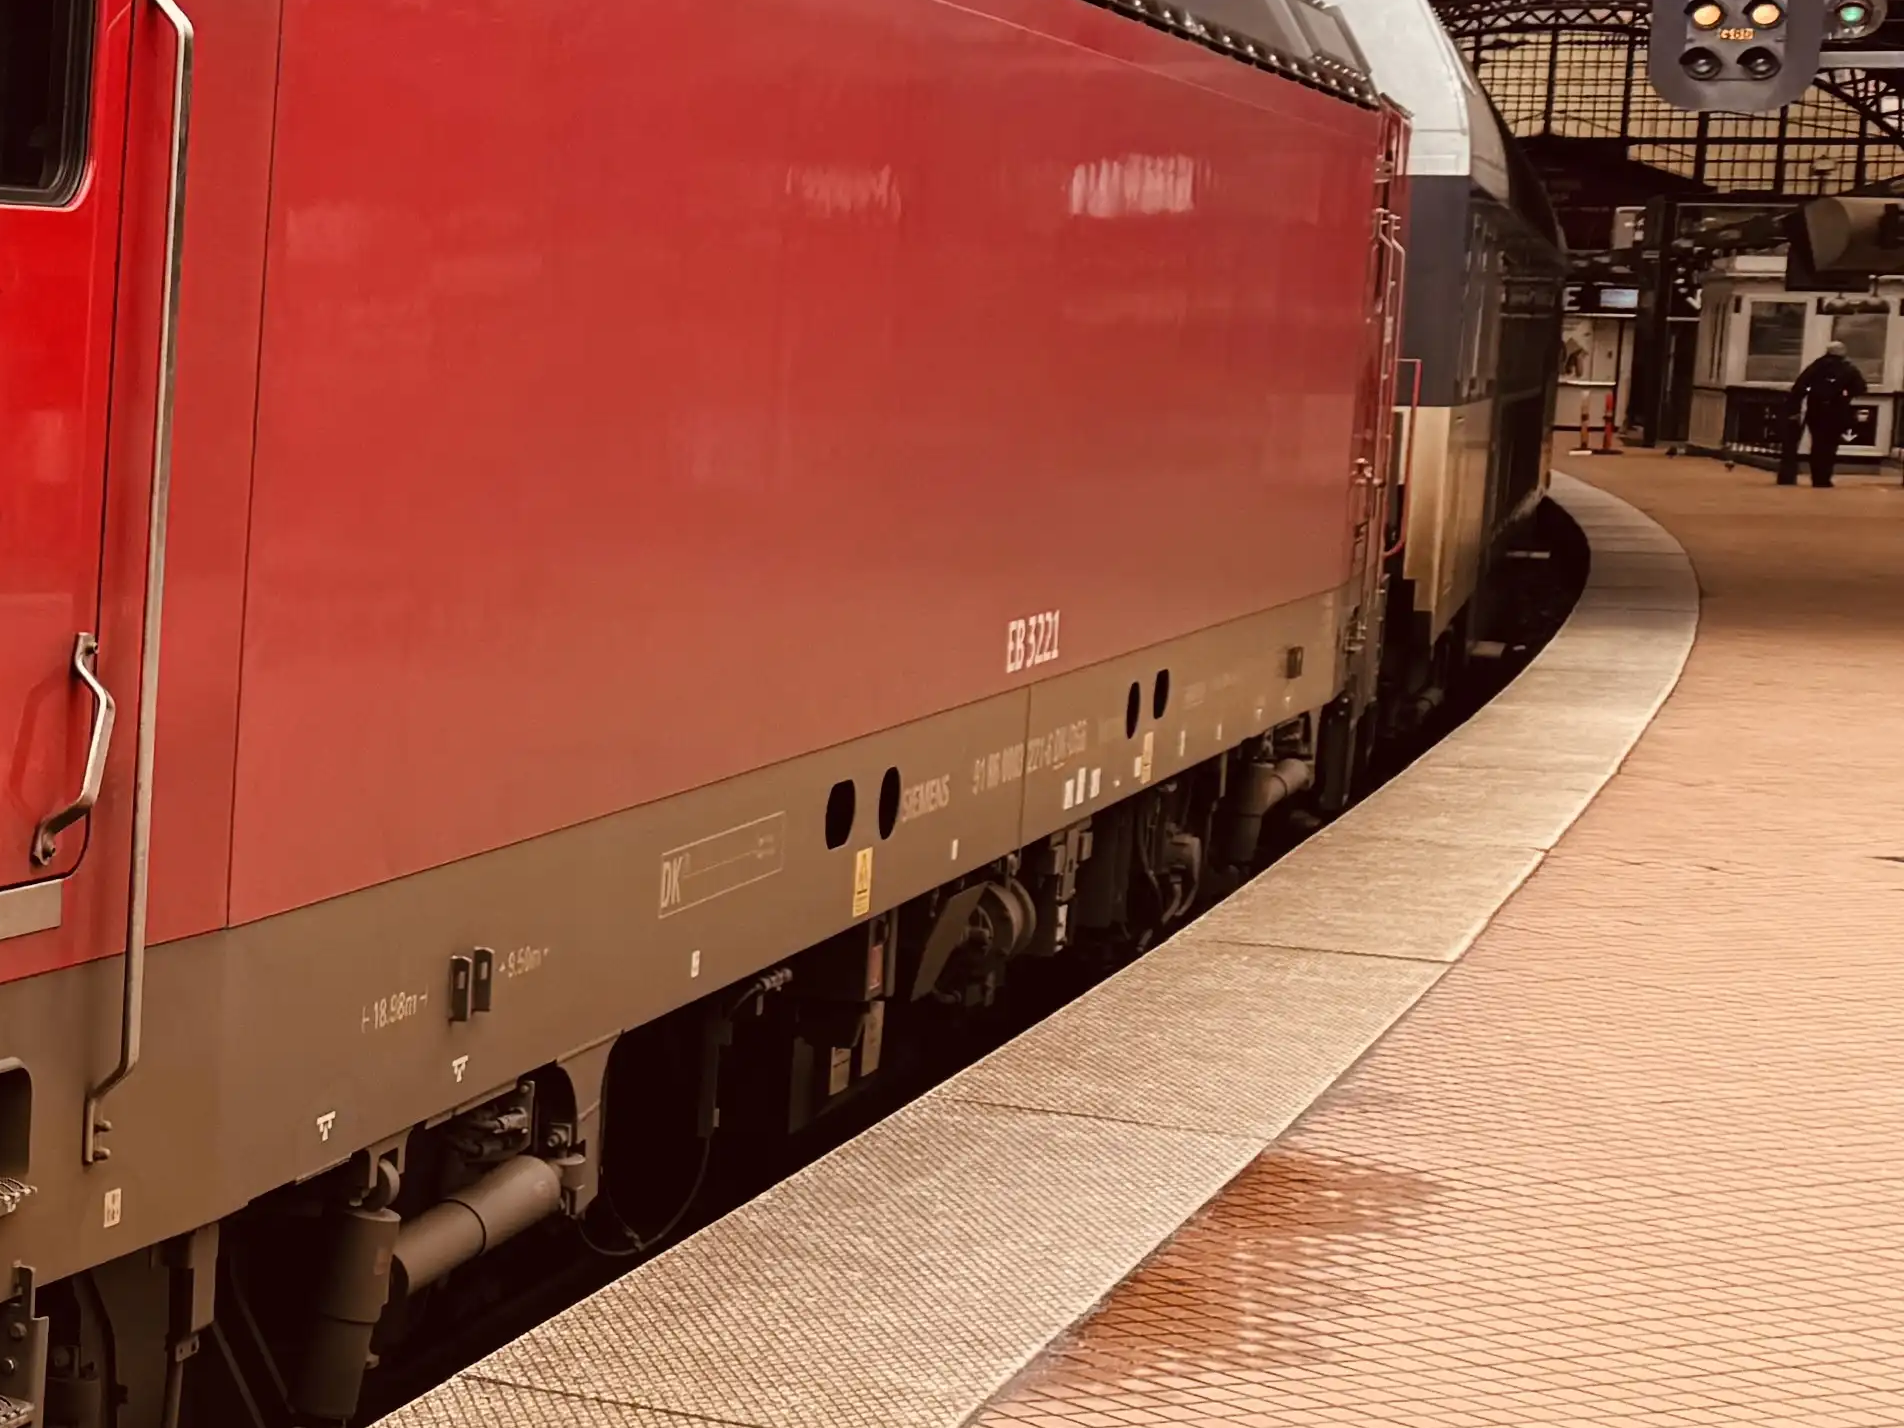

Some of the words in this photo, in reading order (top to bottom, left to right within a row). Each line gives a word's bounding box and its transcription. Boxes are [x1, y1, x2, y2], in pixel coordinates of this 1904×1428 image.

[1006, 618, 1026, 673] EB
[1026, 609, 1060, 668] 3221
[661, 856, 684, 909] DK
